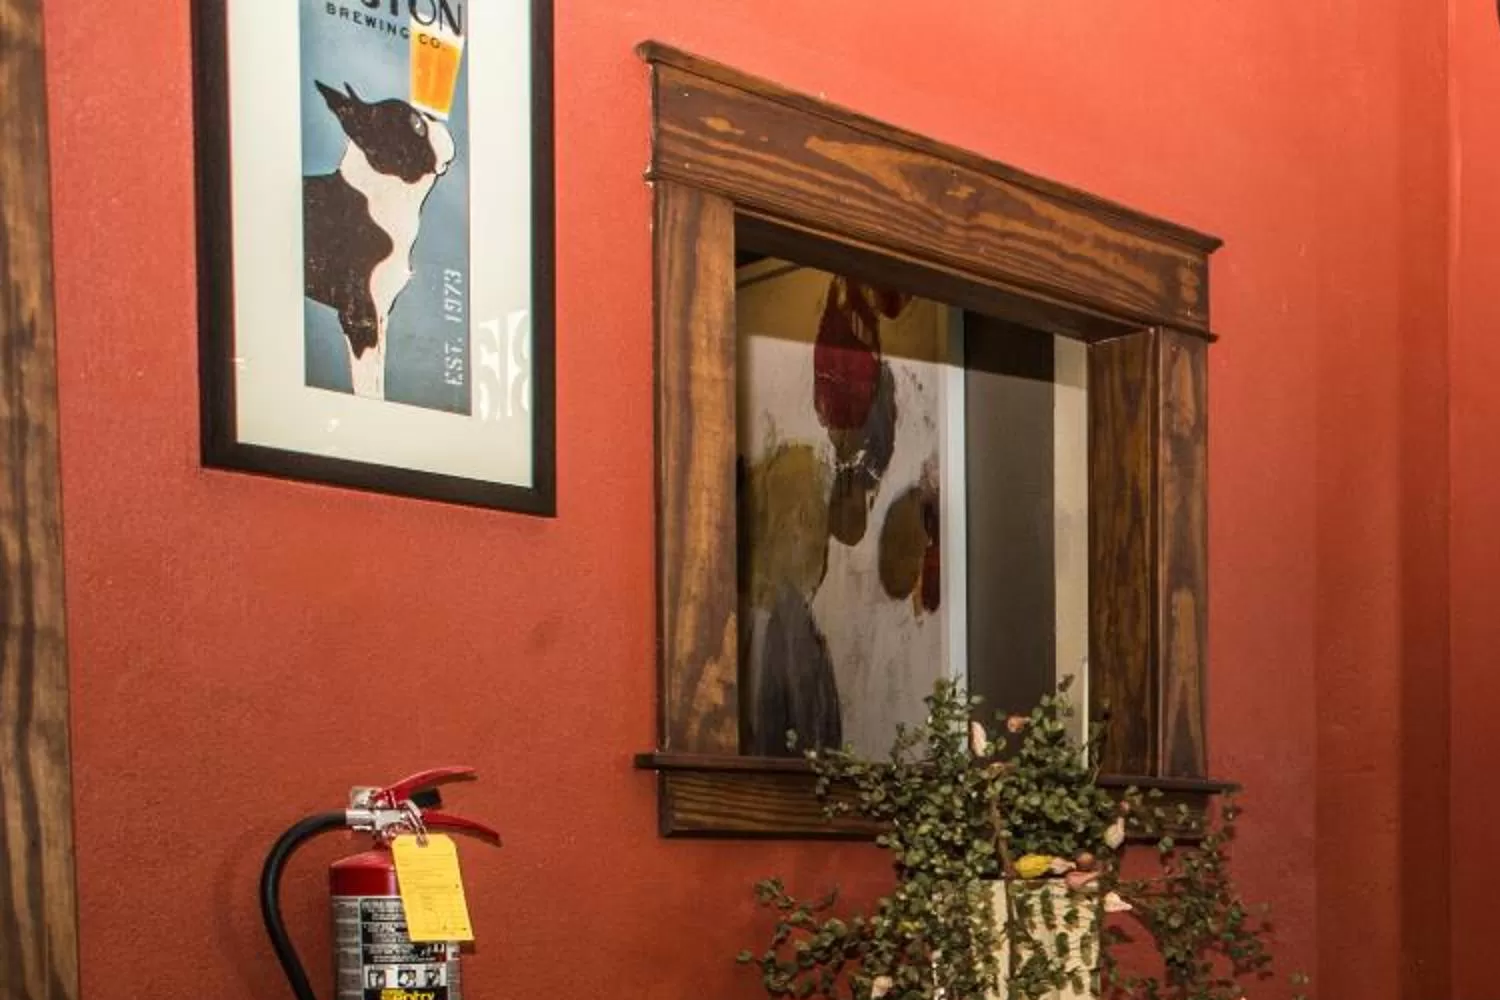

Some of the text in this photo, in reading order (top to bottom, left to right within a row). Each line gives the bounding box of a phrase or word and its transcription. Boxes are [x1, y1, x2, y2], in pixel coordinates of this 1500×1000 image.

[325, 2, 410, 40] BREWING
[361, 0, 462, 36] ON
[443, 268, 464, 386] EST. 1973
